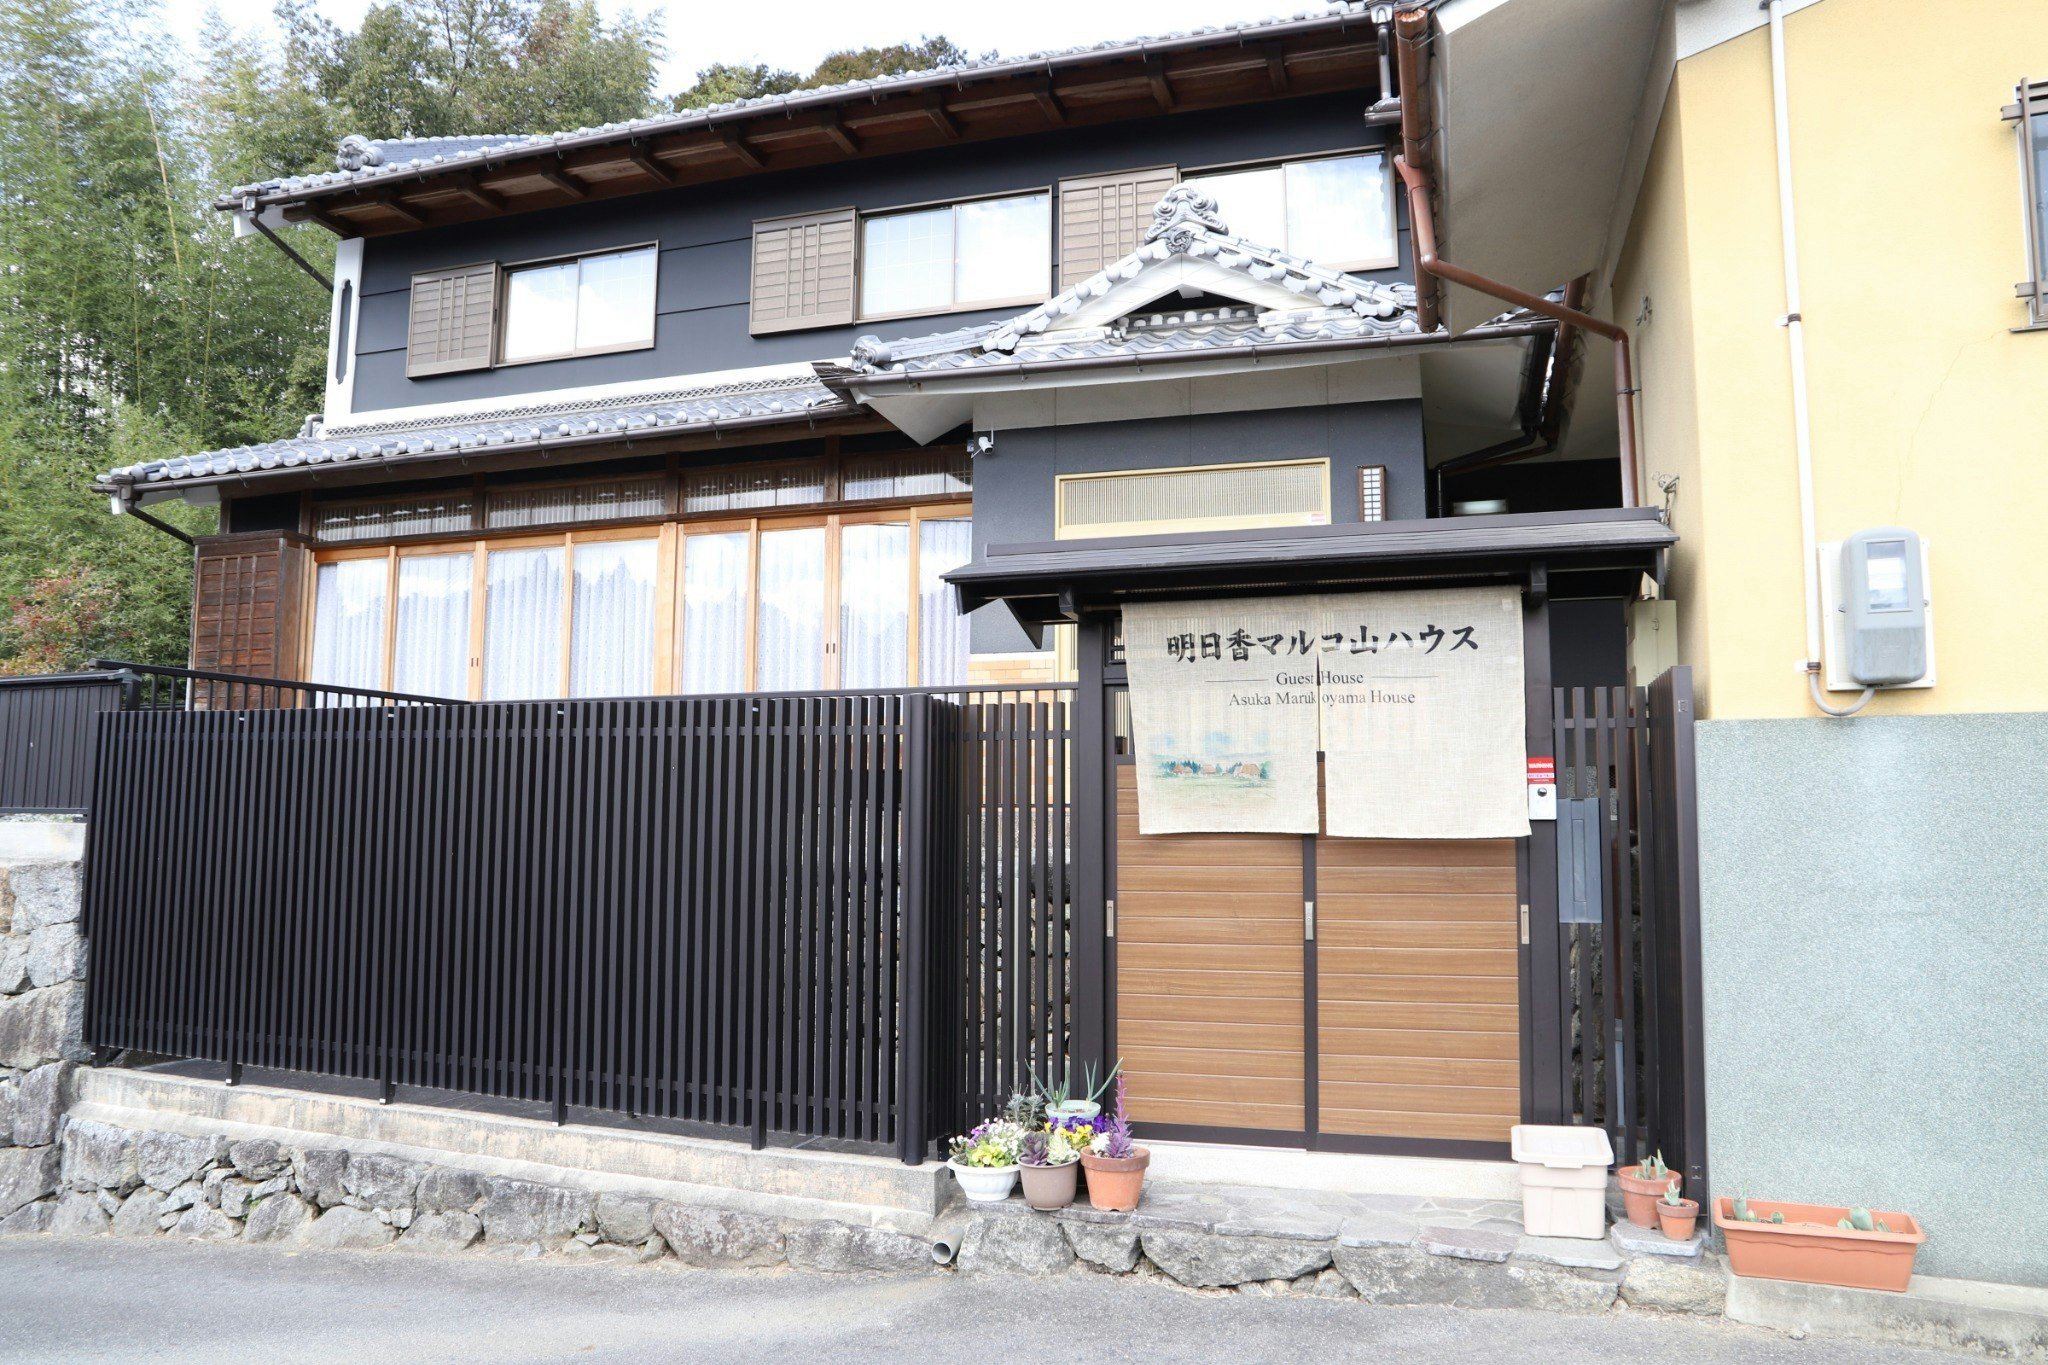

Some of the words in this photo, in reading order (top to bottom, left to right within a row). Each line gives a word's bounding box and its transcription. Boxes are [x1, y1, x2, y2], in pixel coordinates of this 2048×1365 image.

[1167, 624, 1479, 663] 明日香マルコ山ハウス
[1276, 672, 1314, 685] Guest
[1321, 670, 1364, 684] House
[1229, 692, 1271, 706] Asuka
[1276, 690, 1366, 706] Marukoyama
[1371, 690, 1416, 704] House
